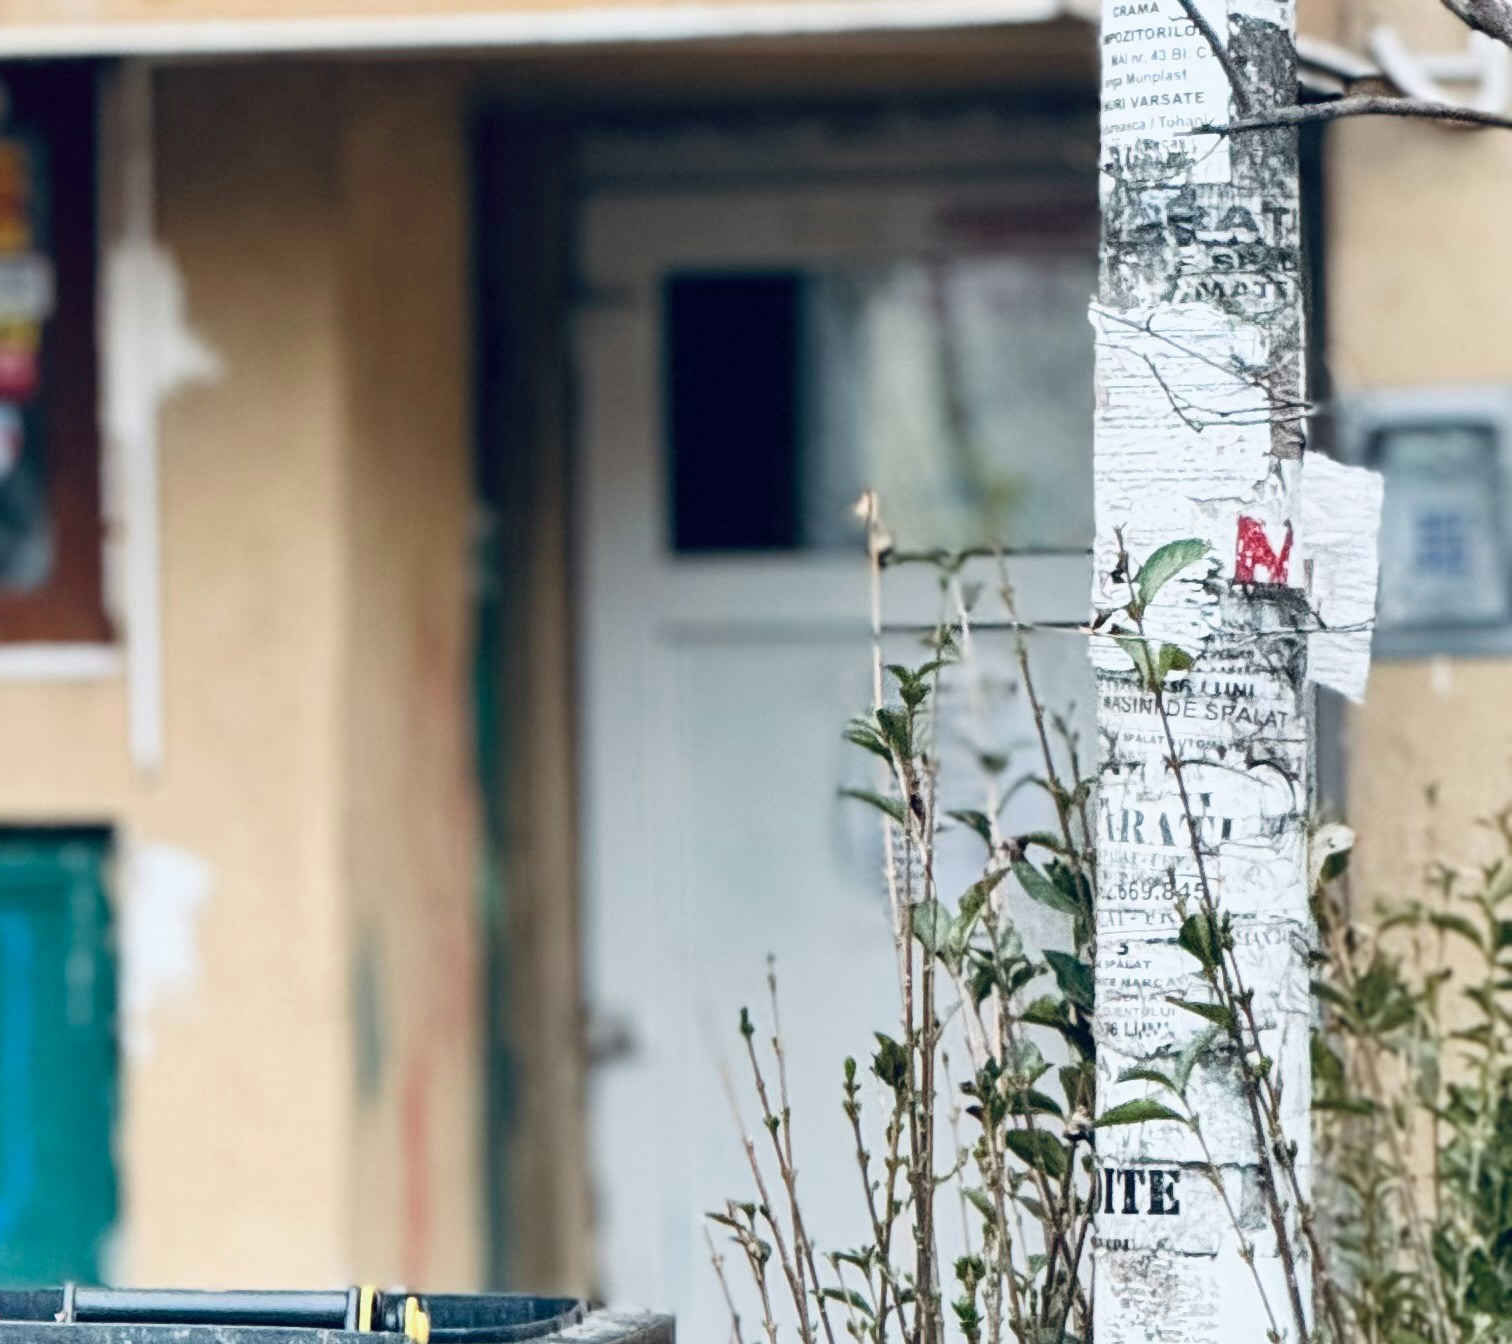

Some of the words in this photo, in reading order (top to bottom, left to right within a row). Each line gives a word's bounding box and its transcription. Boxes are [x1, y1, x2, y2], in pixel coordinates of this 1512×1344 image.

[1112, 1, 1160, 18] CRAMA
[1130, 91, 1206, 108] VARSATE
[1166, 699, 1197, 719] DE
[1205, 701, 1289, 729] SPALAT
